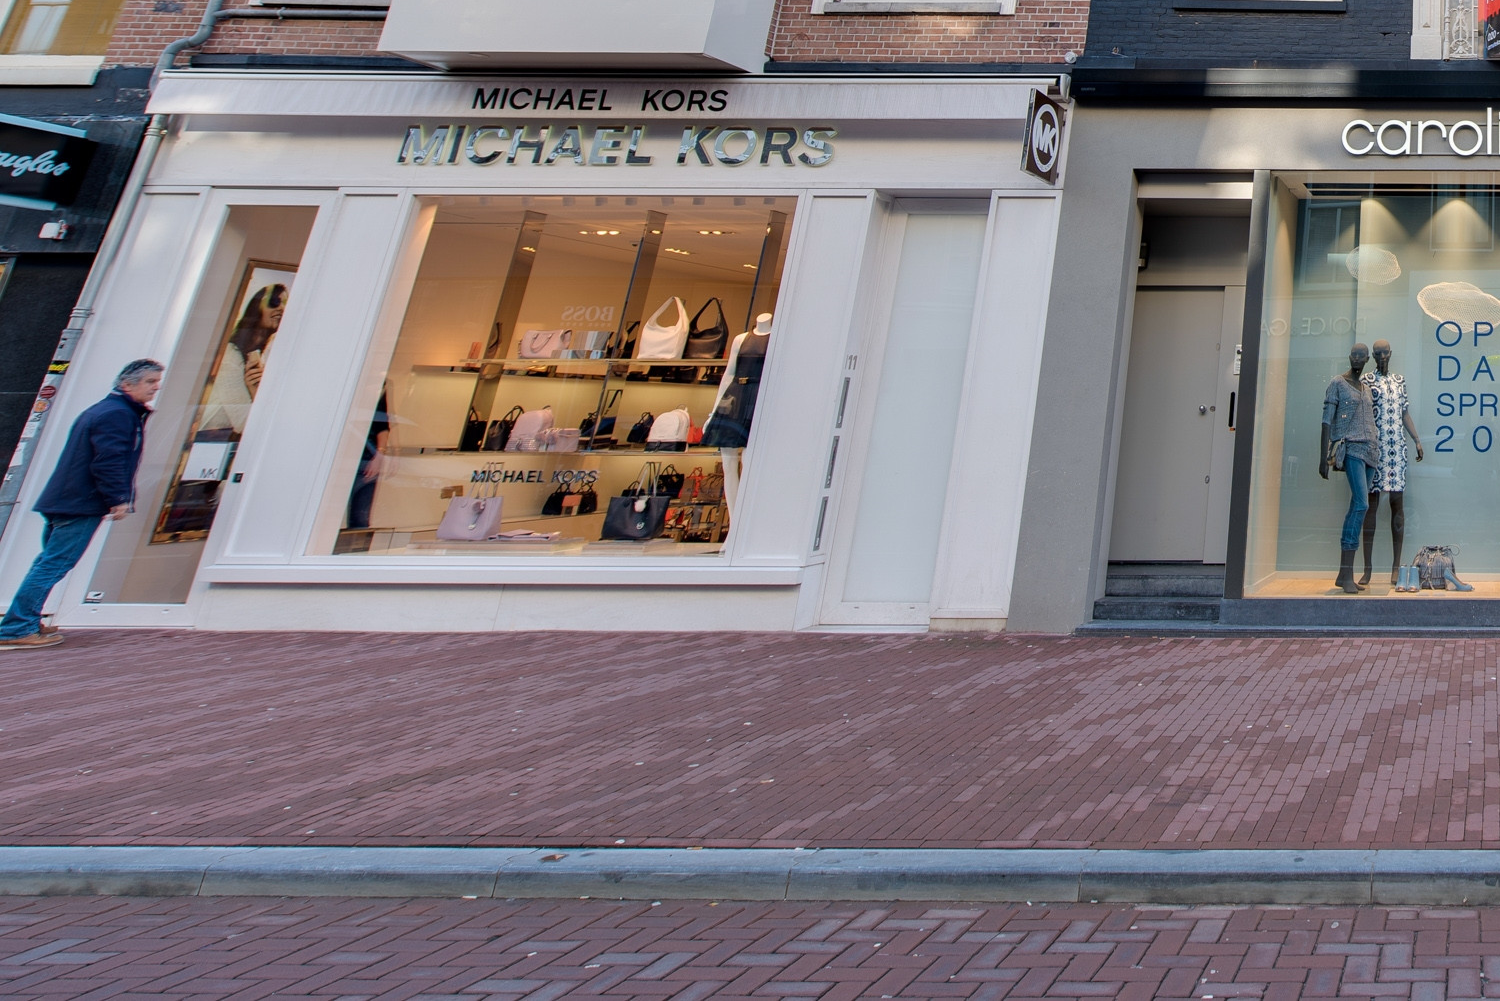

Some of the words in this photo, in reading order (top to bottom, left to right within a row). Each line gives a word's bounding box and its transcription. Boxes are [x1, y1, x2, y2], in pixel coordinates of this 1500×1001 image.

[471, 87, 613, 111] MICHAEL
[640, 88, 729, 112] KORS
[397, 124, 653, 166] MICHAEL
[676, 125, 839, 167] KORS
[1032, 117, 1057, 159] MK
[470, 470, 545, 483] MICHAEL
[551, 470, 598, 484] KORS
